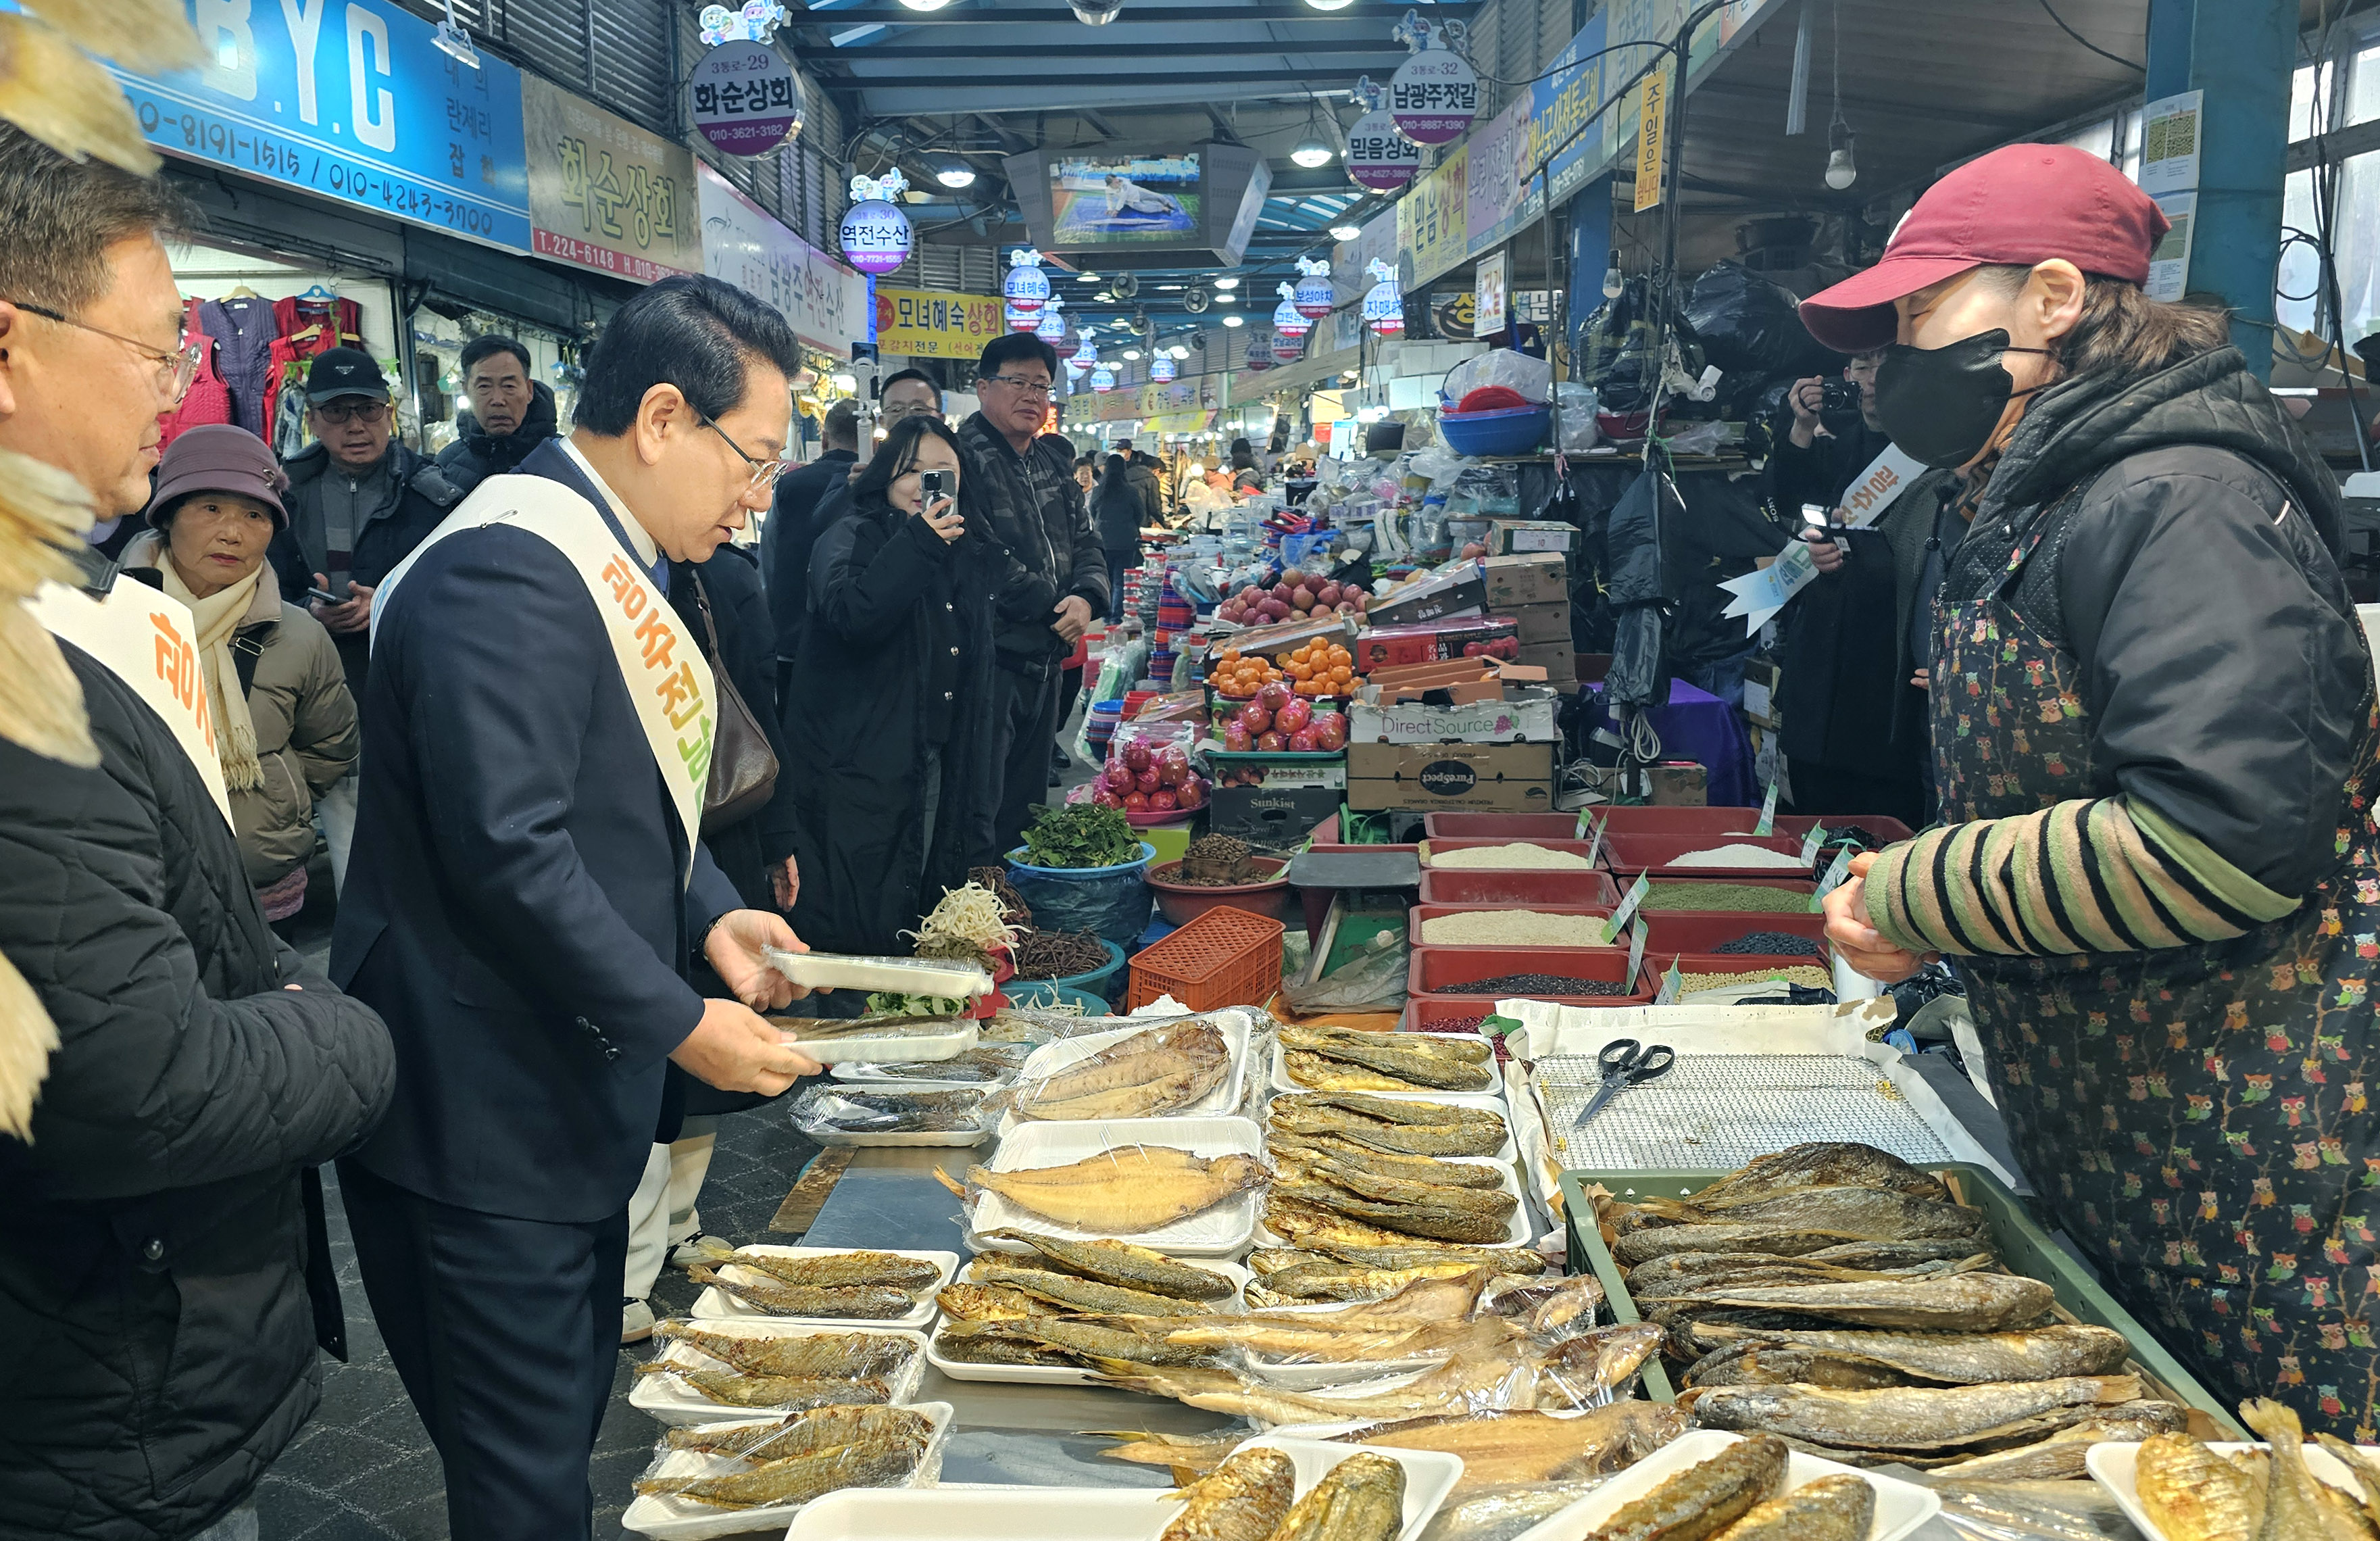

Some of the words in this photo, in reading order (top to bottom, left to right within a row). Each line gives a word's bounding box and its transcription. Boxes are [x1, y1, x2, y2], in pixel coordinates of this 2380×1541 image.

[712, 54, 770, 74] 3통로-29
[1411, 62, 1458, 75] 3통로-32
[695, 76, 794, 116] 화순상회
[1393, 82, 1477, 109] 남광주젓갈
[710, 124, 784, 141] 010-3621-3182
[1643, 82, 1661, 172] 주일은
[1350, 137, 1419, 160] 믿음상회
[126, 95, 300, 177] 0-8191-1515
[329, 164, 493, 235] 010-4243-3700
[557, 136, 679, 257] 화순상회
[842, 225, 909, 246] 역전수산
[539, 231, 614, 269] T.224-6148
[1006, 281, 1047, 295] 모녀혜숙
[1766, 495, 1780, 524] SONY
[1422, 773, 1474, 785] PureSpect
[1250, 797, 1295, 810] Sunkist
